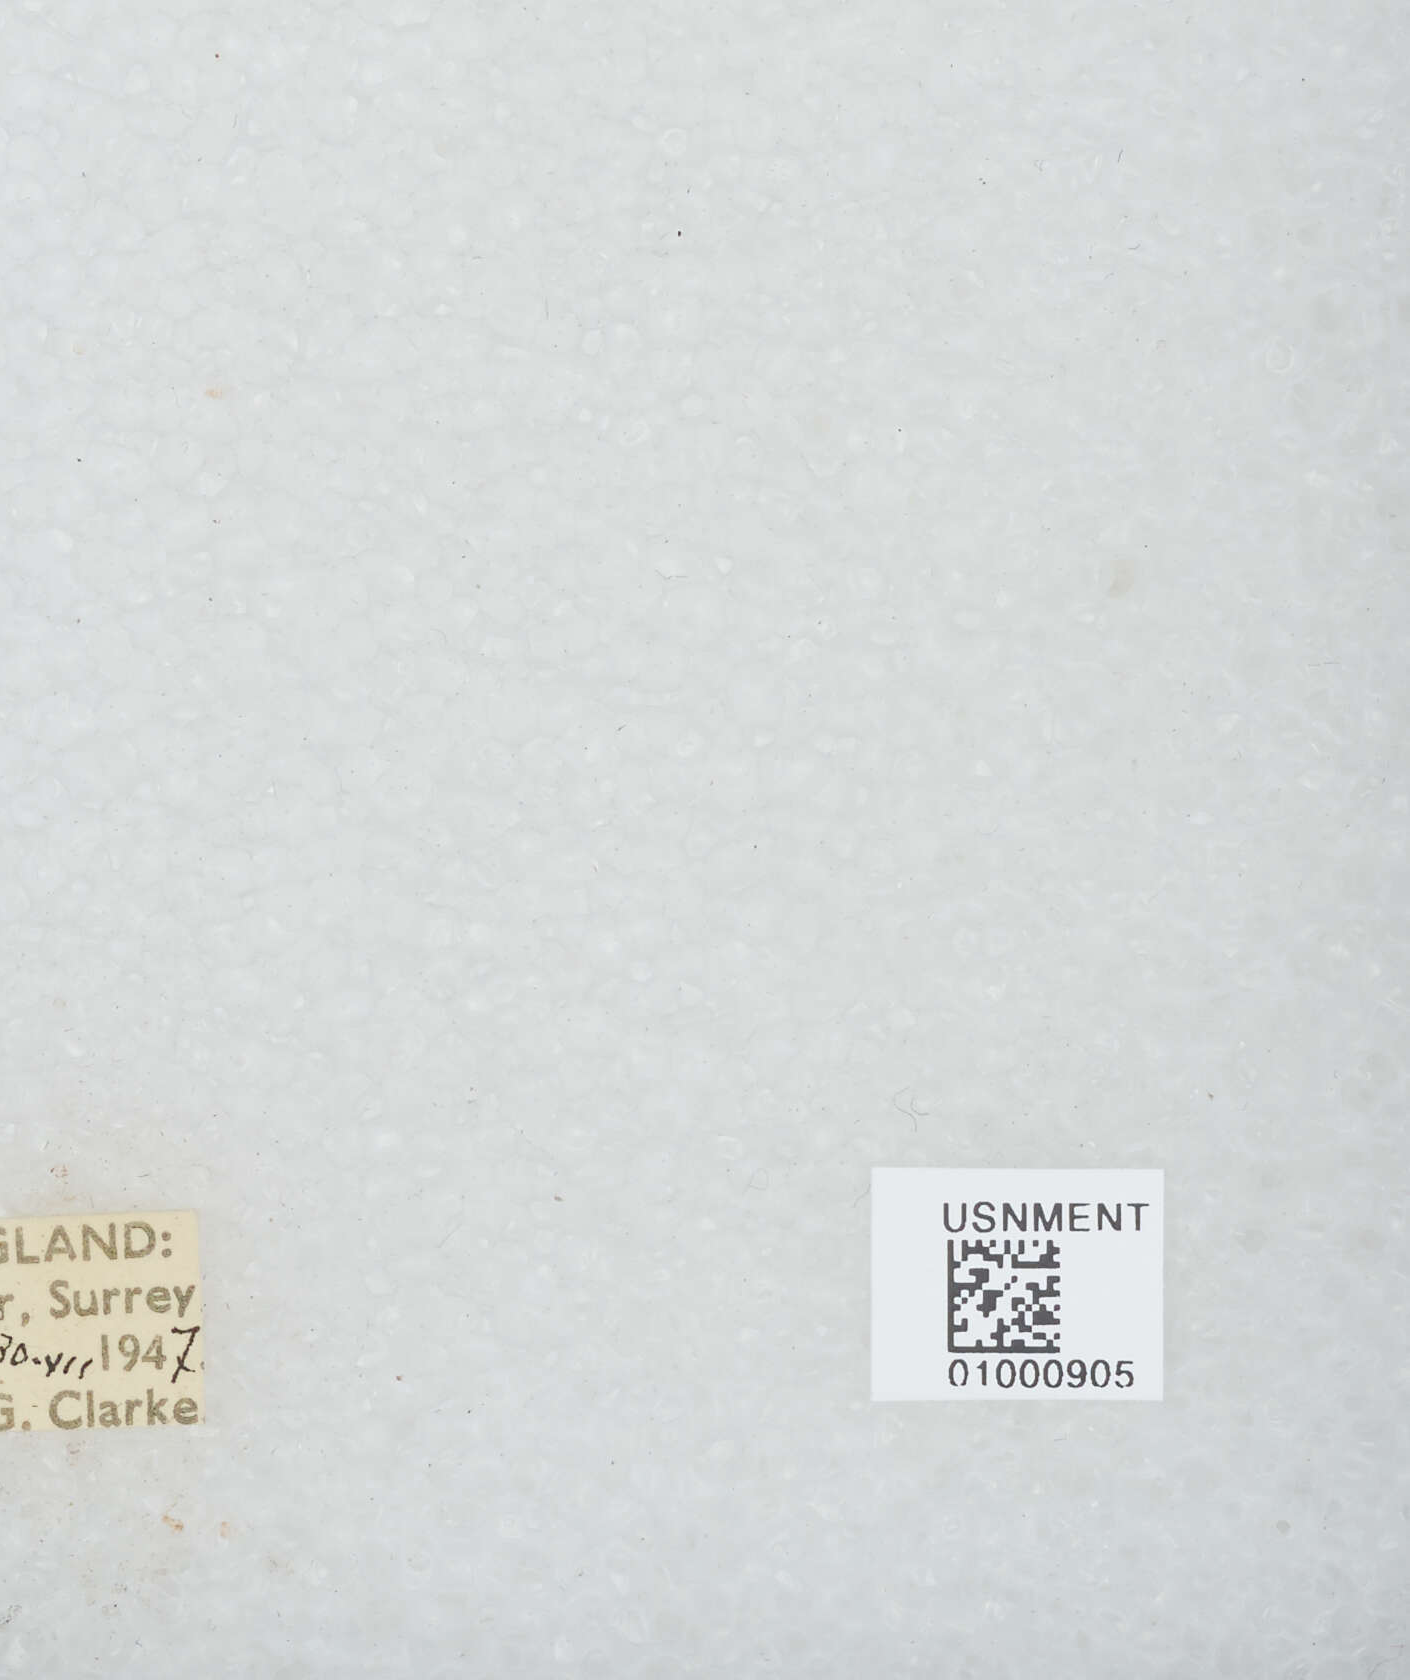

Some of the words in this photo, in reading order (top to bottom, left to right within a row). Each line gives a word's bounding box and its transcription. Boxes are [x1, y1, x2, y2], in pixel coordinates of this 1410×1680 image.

[942, 1201, 1150, 1233] USNMENT
[48, 1279, 196, 1318] Surrey
[948, 1359, 1135, 1388] 01000905
[48, 1389, 198, 1430] Clarke
